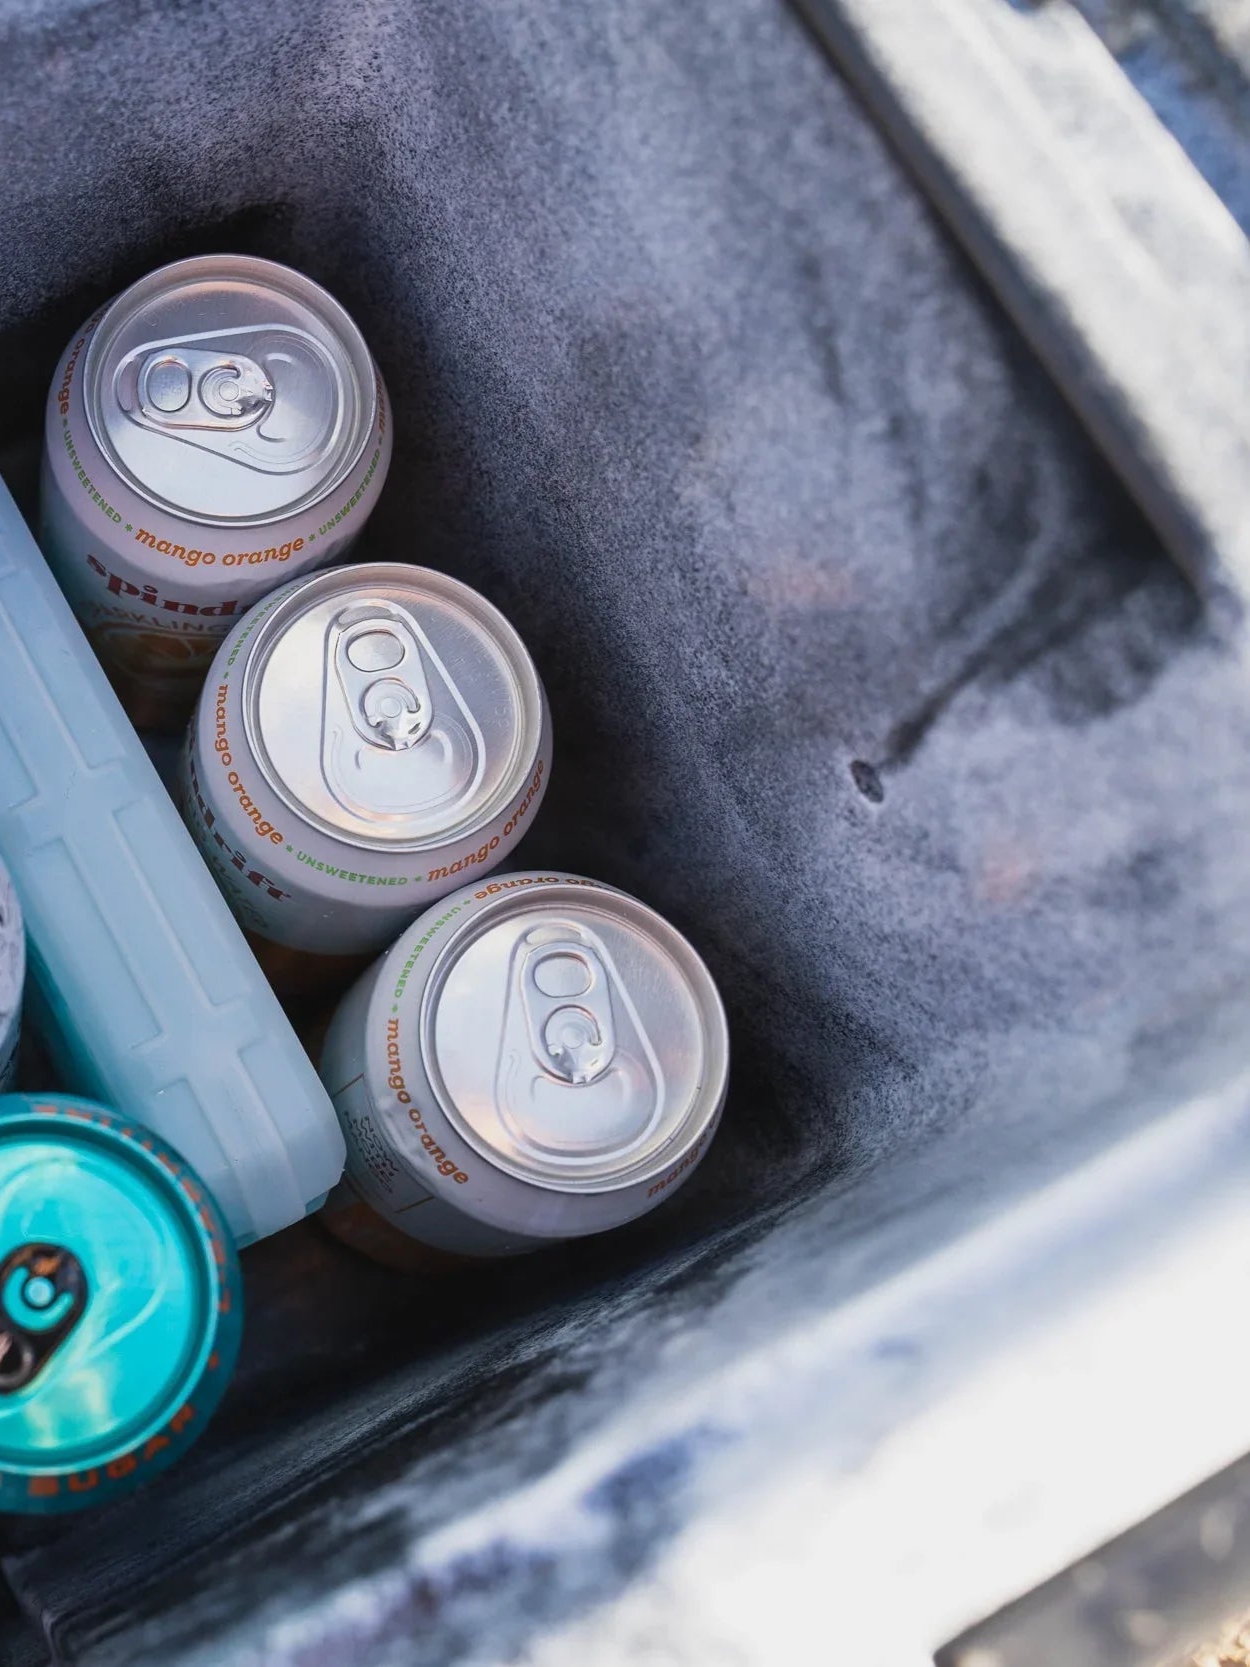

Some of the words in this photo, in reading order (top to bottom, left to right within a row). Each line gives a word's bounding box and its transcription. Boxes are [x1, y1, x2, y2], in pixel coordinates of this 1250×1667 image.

[57, 338, 85, 415] orange
[63, 432, 122, 525] UNSWEETENED
[318, 448, 381, 537] UNSWEETENED
[134, 527, 216, 567] mango
[221, 536, 306, 567] orange
[214, 683, 232, 767] mango
[227, 770, 285, 846] orange
[296, 850, 409, 887] UNSWEETENED
[427, 835, 501, 882] mango
[503, 759, 544, 836] orange
[473, 876, 560, 900] orange
[393, 906, 462, 999] UNSWEETENED
[385, 1017, 412, 1105] mango
[408, 1107, 470, 1185] orange
[27, 1403, 195, 1498] SUGAR
